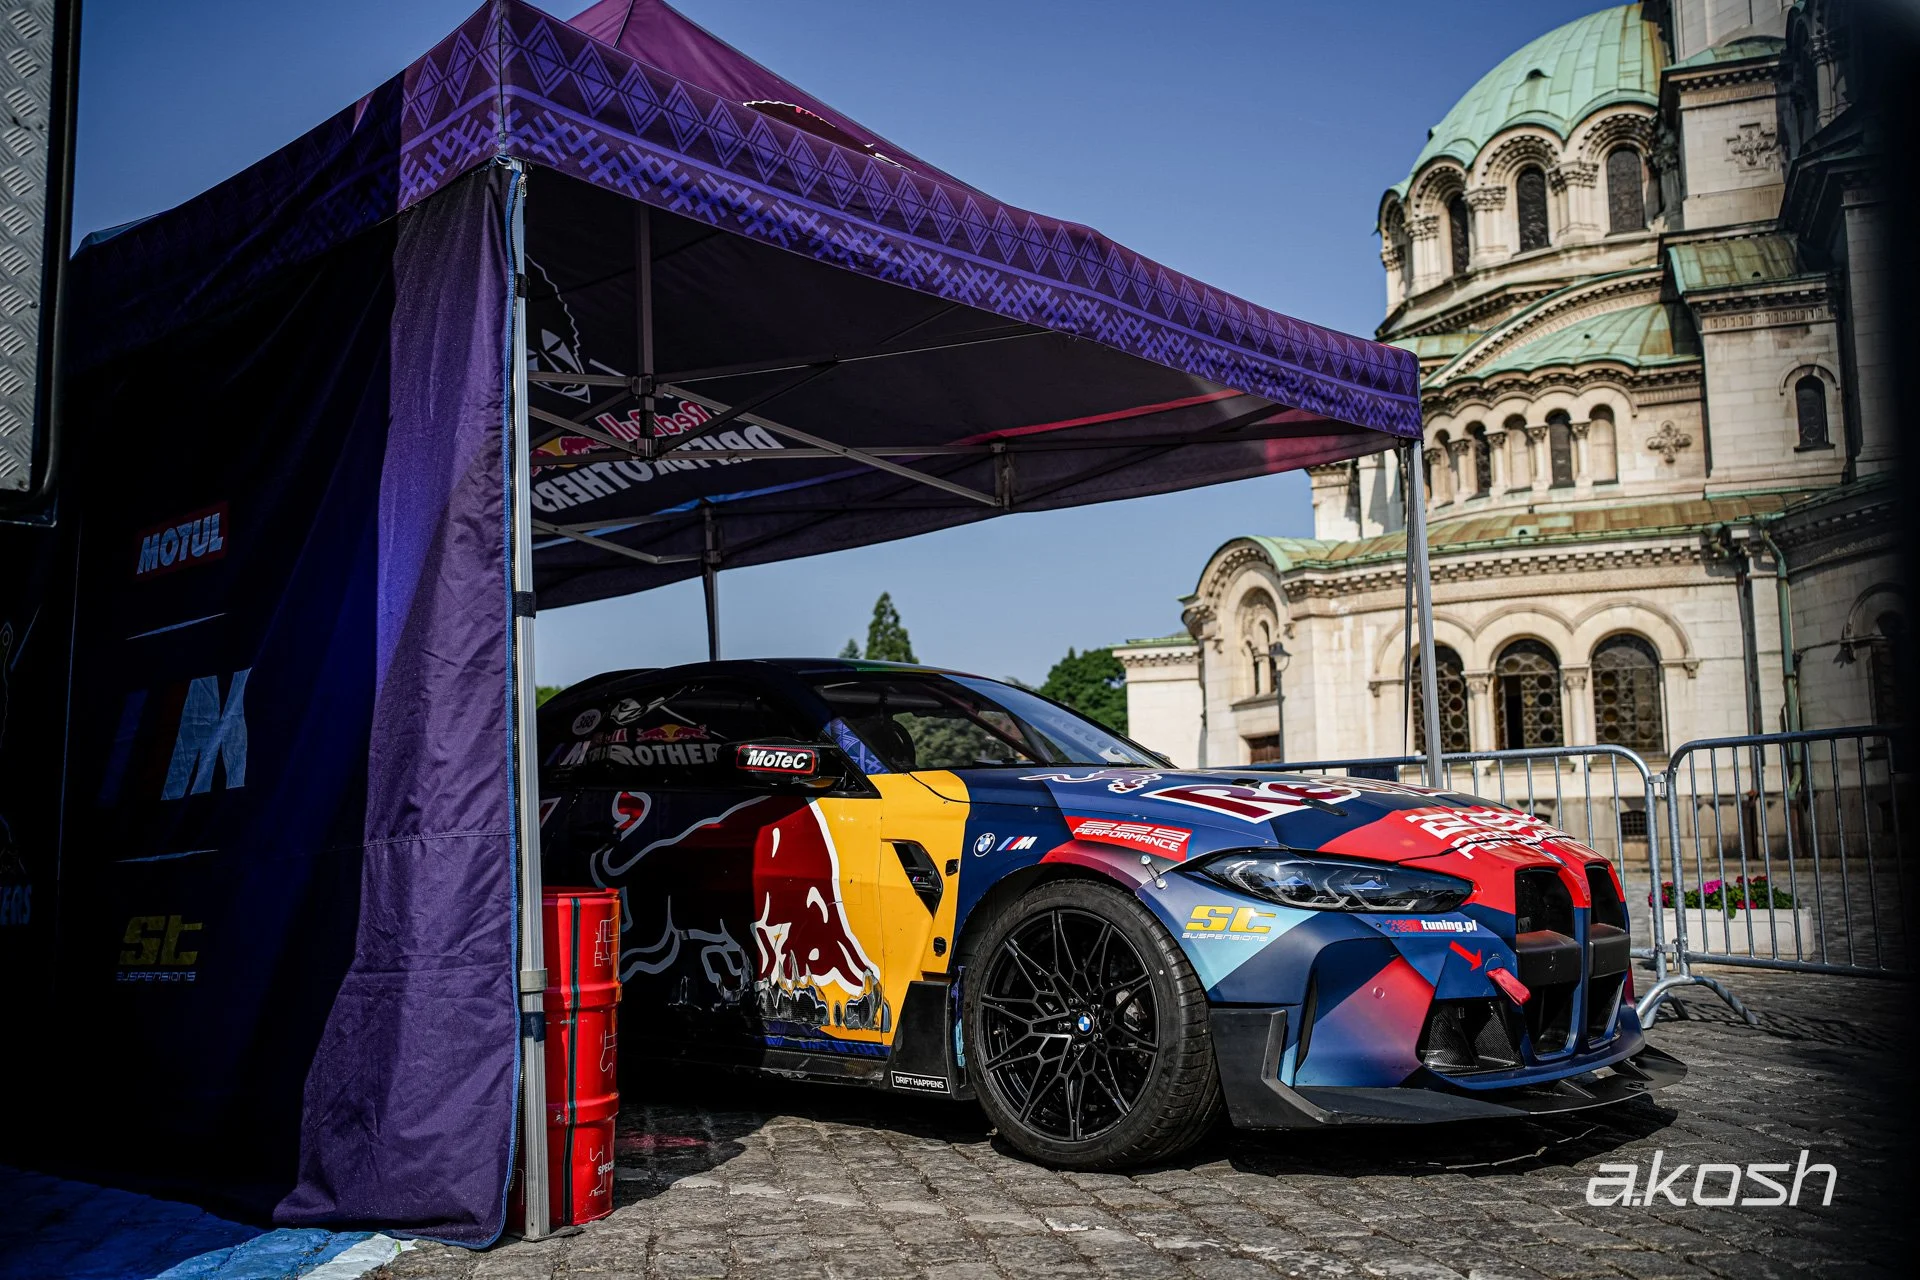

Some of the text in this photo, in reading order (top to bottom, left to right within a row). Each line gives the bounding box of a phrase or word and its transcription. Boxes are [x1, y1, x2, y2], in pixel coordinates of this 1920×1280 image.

[136, 512, 224, 576] MOTUL
[747, 749, 808, 769] MoTeC
[1073, 827, 1181, 852] PERFORMANCE
[1421, 919, 1478, 932] tuning.pl
[895, 1076, 944, 1089] DRIFT HAPPENS
